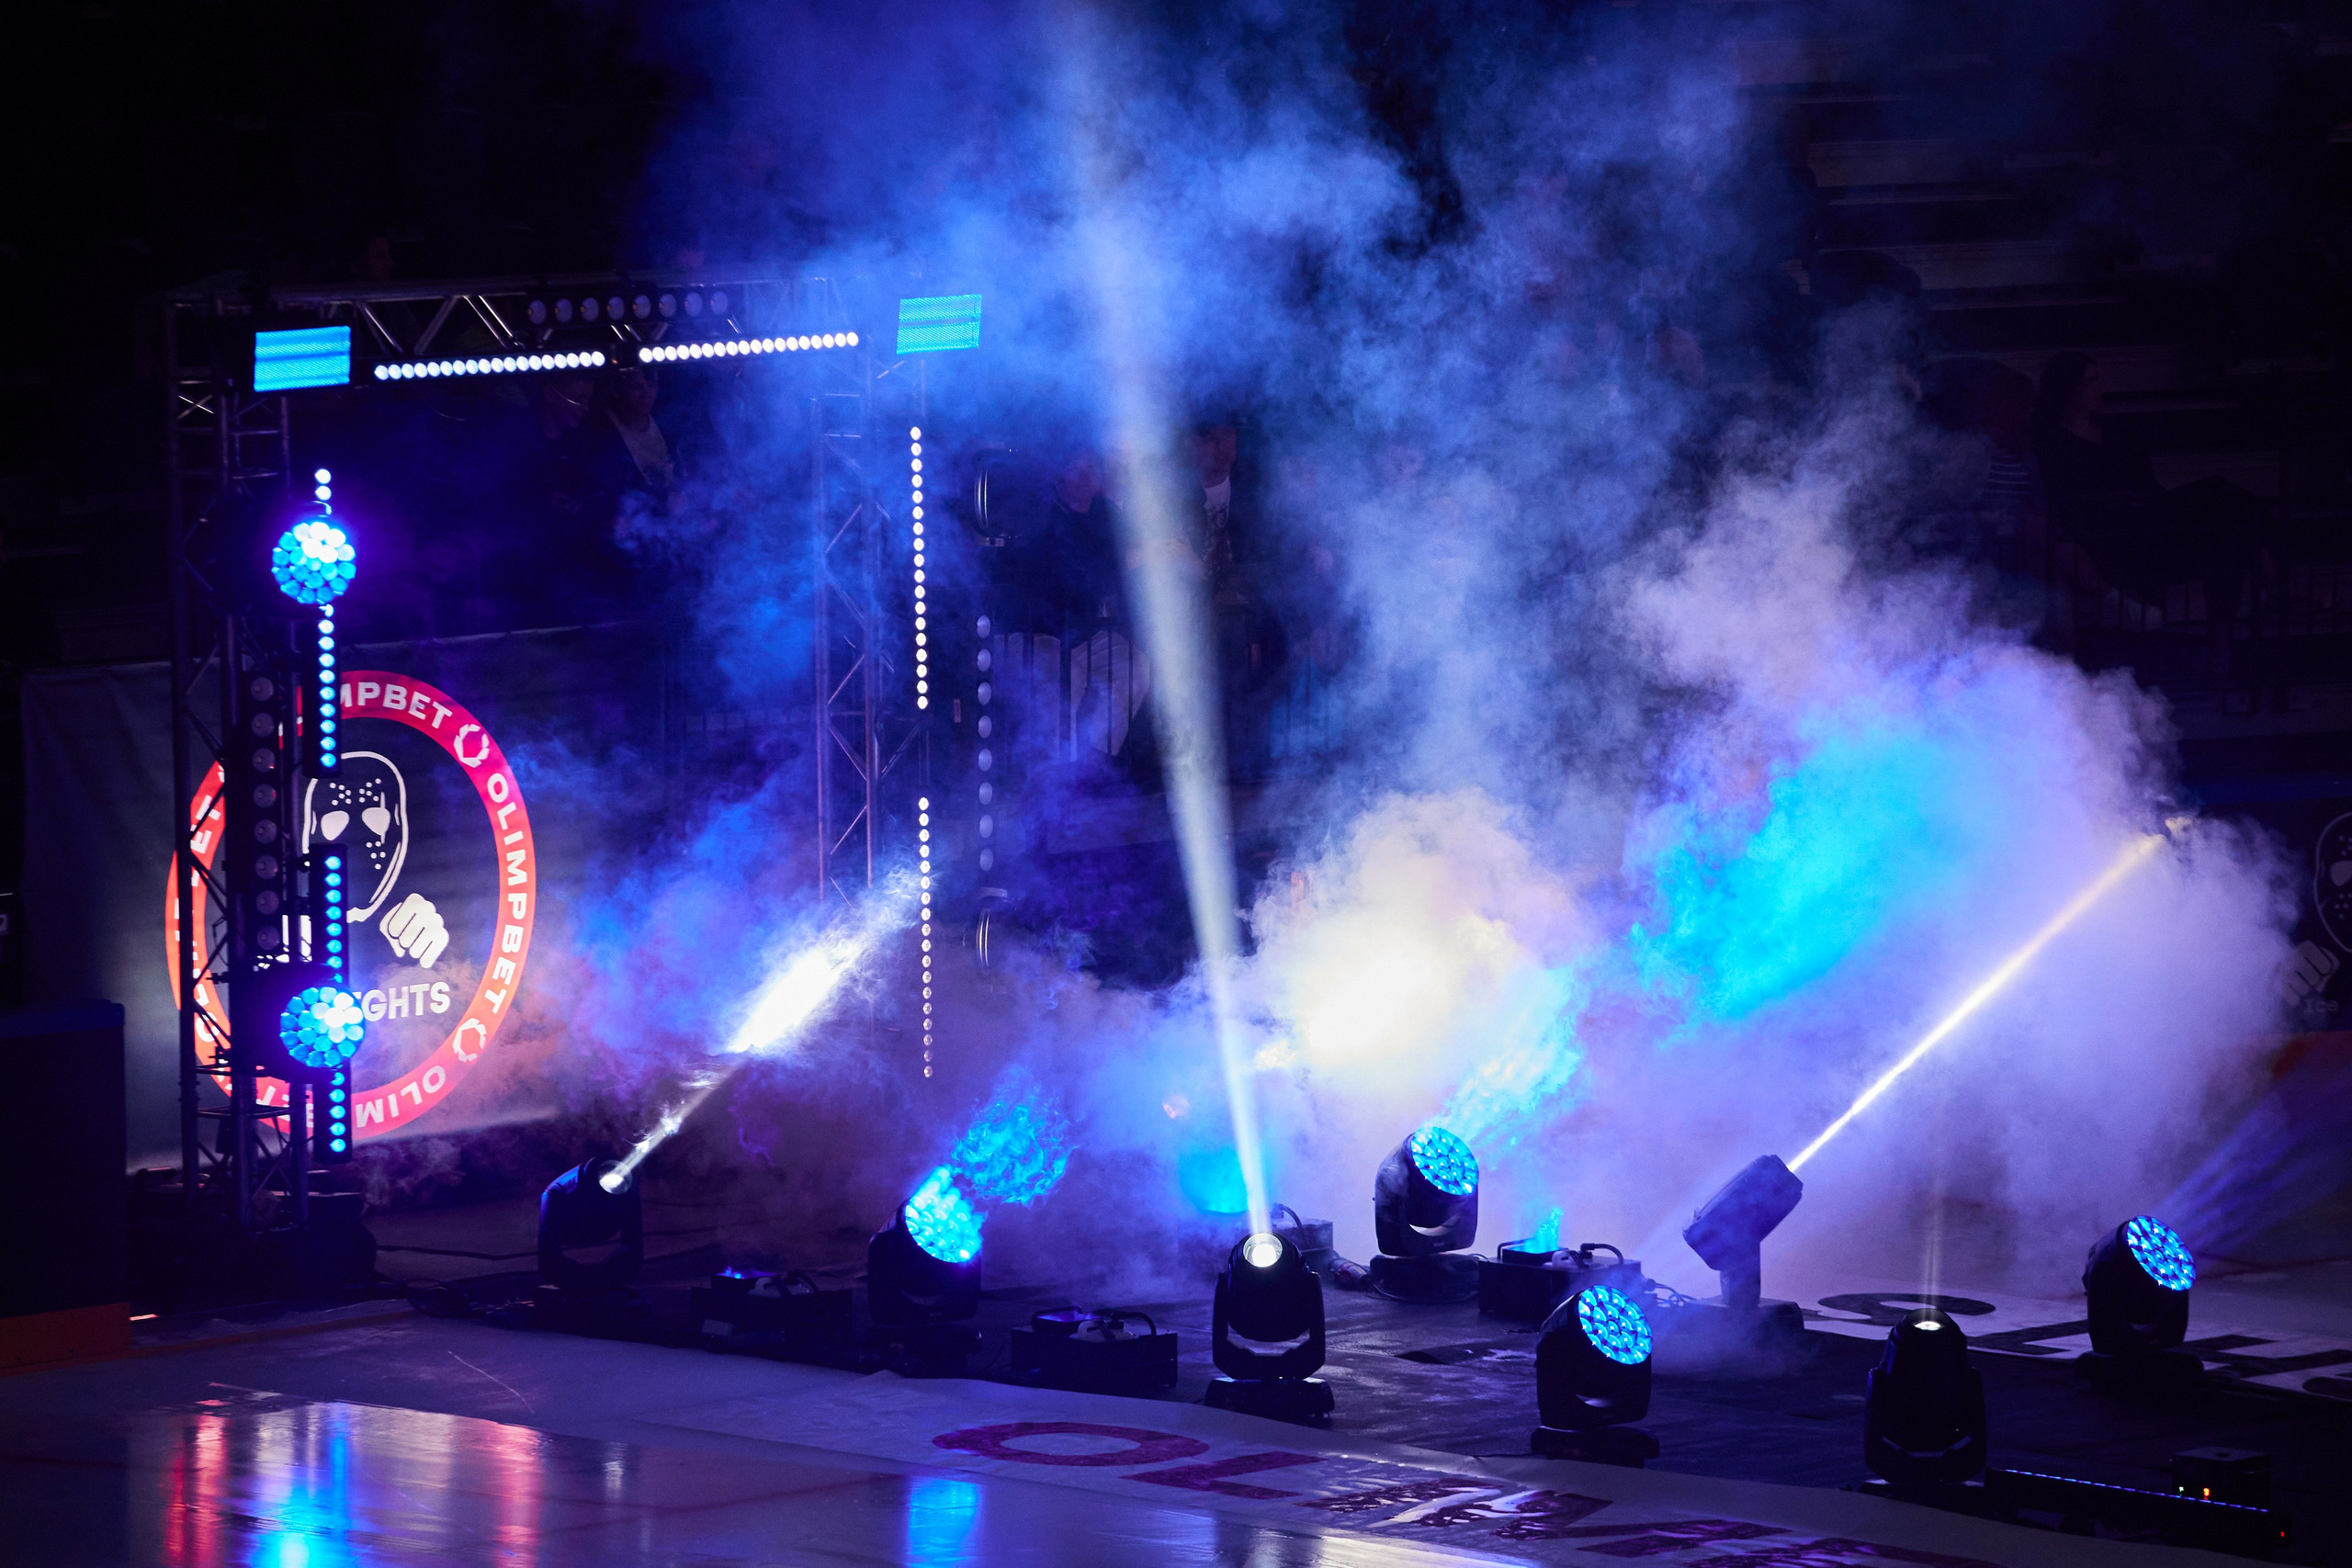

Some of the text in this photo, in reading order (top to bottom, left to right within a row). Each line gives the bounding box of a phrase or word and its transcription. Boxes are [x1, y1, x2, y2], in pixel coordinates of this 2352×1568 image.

[340, 682, 453, 729] PBET
[485, 773, 527, 1013] OLIMPBET
[353, 981, 450, 1021] GHTS
